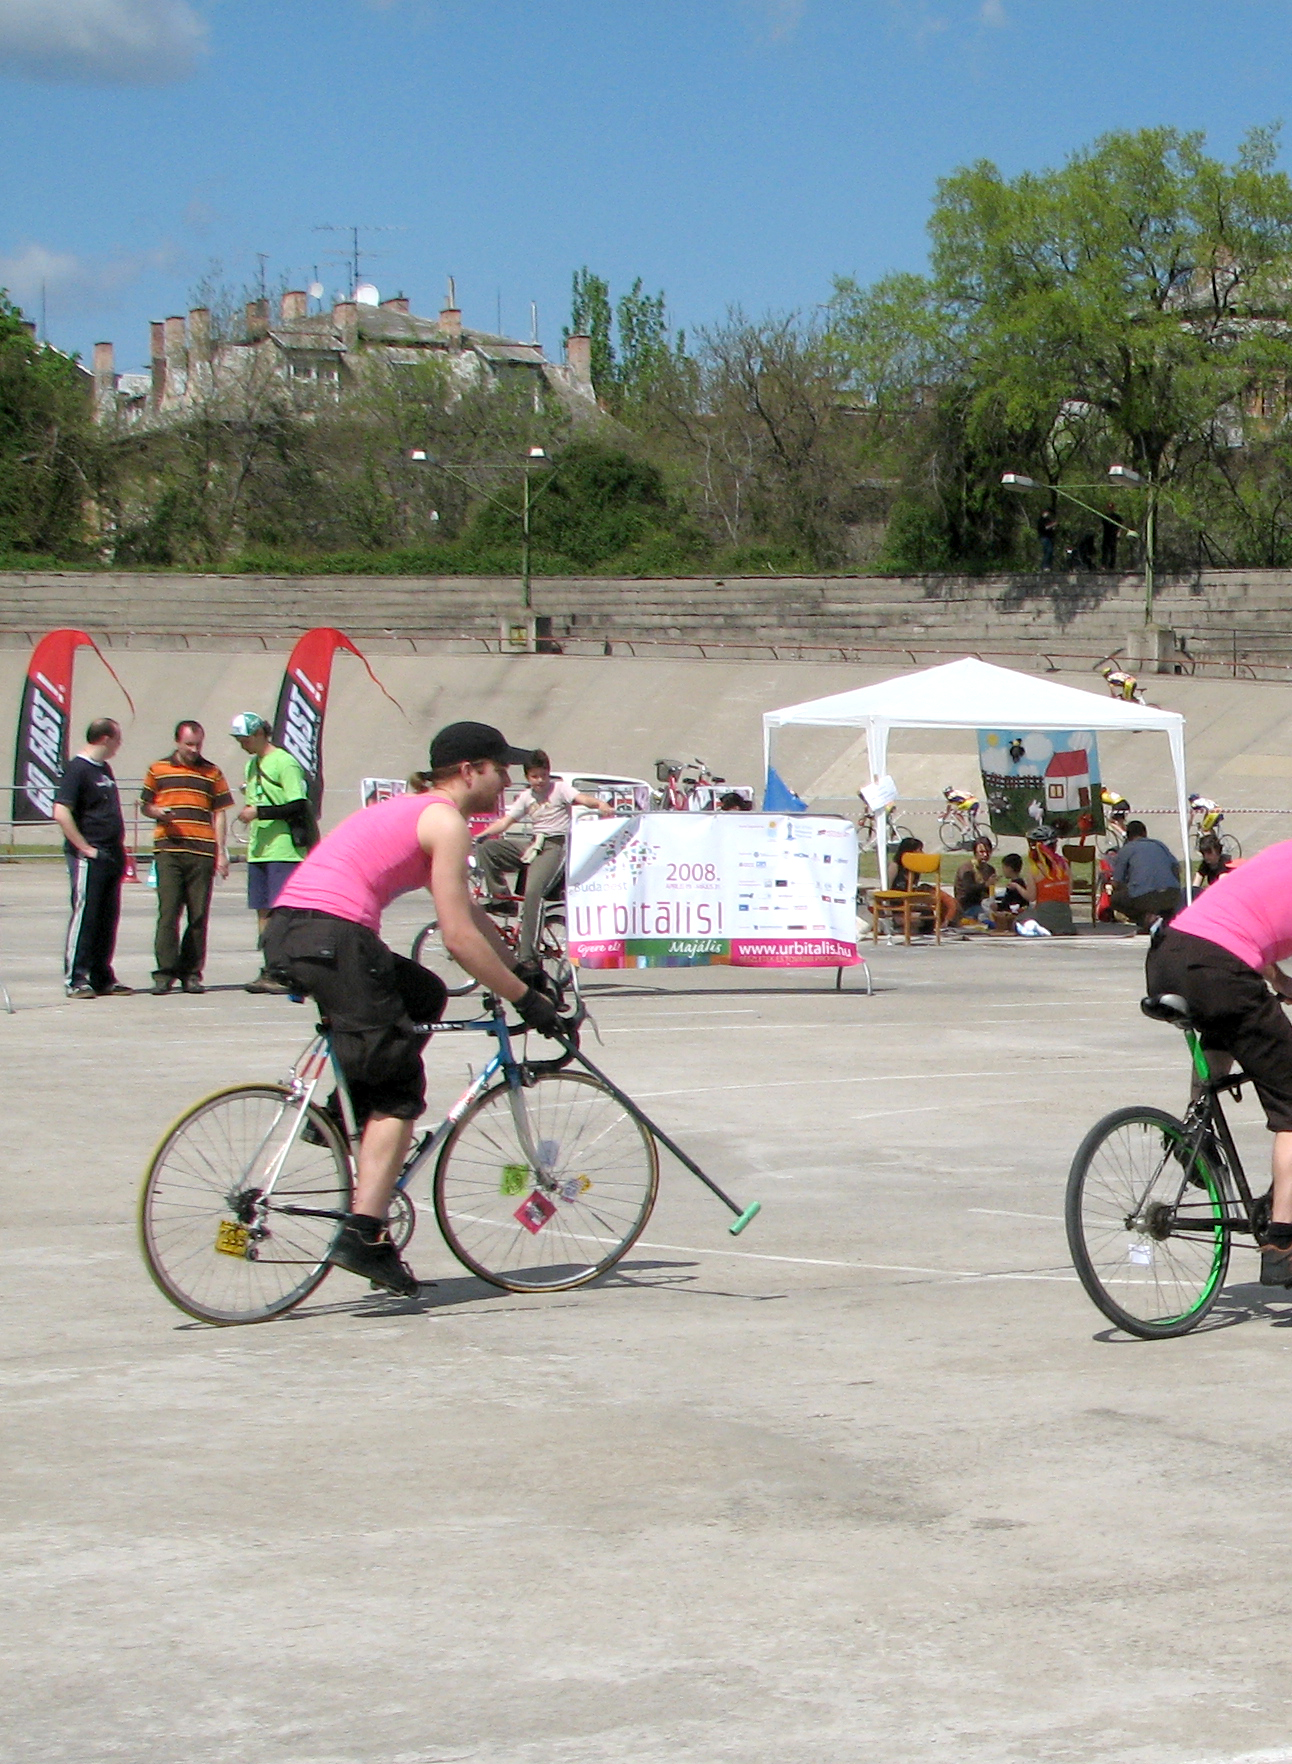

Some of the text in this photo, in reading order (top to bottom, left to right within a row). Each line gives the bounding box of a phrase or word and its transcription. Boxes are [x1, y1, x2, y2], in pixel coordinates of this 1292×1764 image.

[27, 761, 56, 818] GO
[666, 863, 721, 881] 2008.
[668, 940, 722, 958] Majális
[738, 941, 852, 957] www.urbitalis.hu
